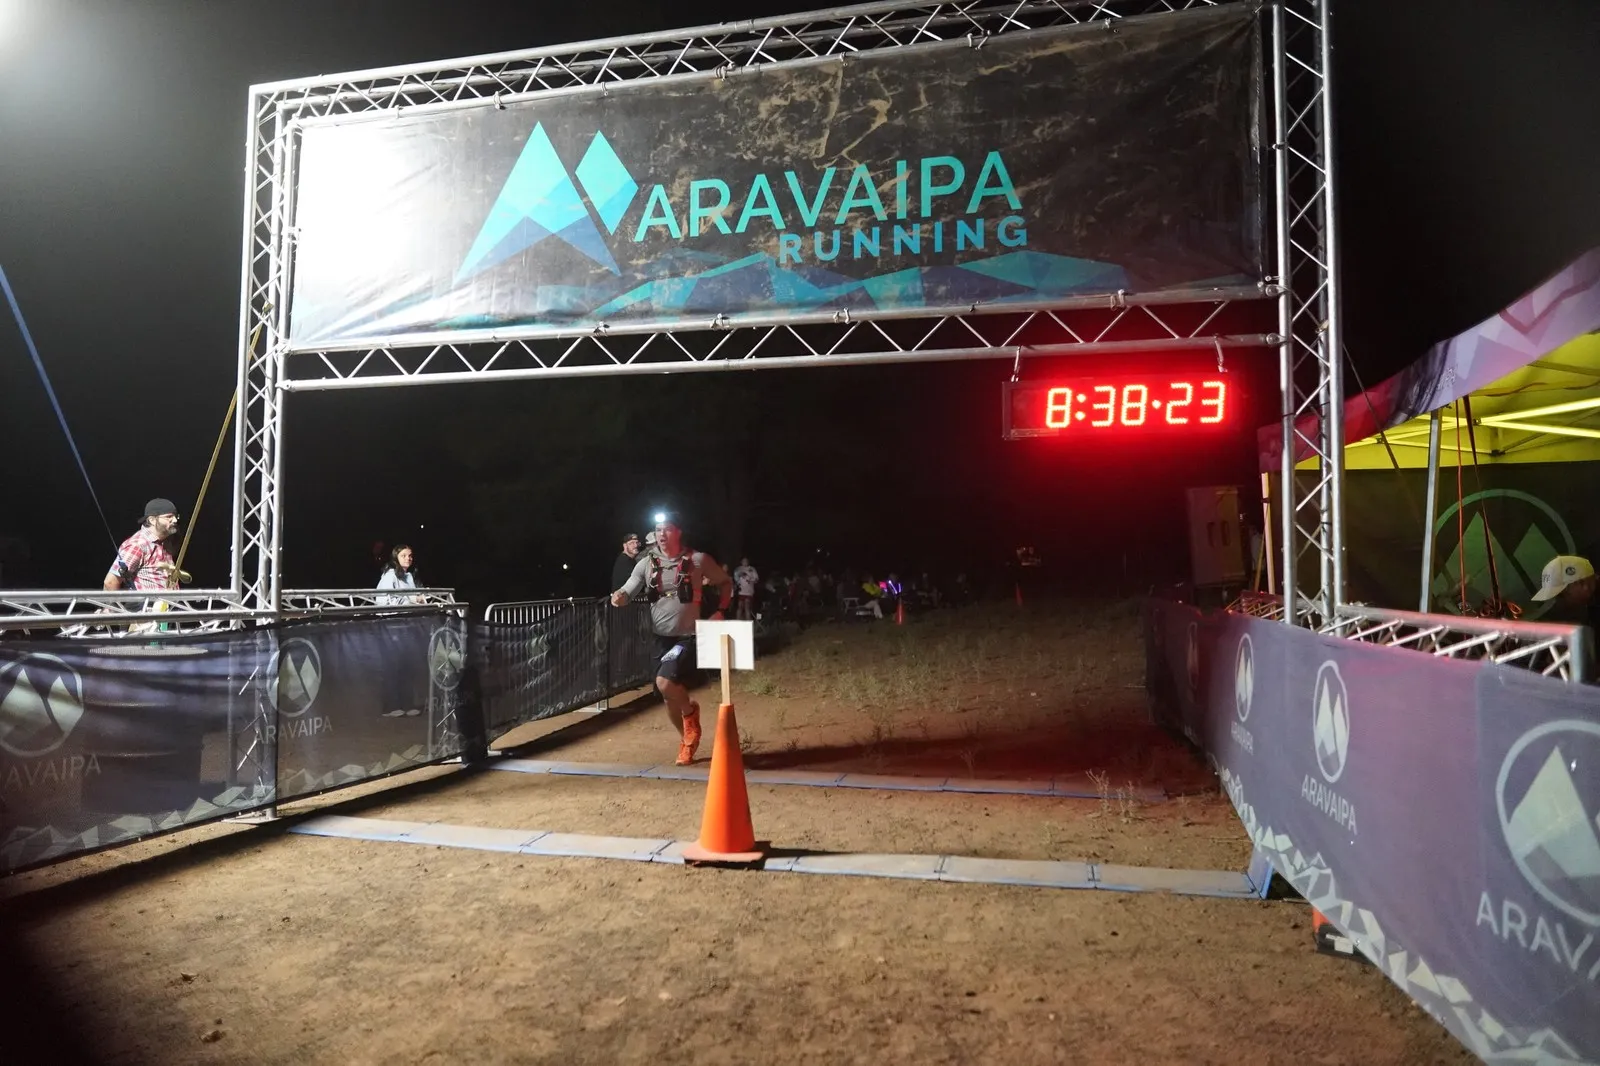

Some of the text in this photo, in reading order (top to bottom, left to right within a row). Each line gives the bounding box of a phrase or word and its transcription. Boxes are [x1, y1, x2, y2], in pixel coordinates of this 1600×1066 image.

[634, 151, 1023, 242] ARAVAIPA
[779, 215, 1028, 264] RUNNING
[0, 753, 102, 791] AVAIPA
[1301, 774, 1357, 835] ARAVAIPA
